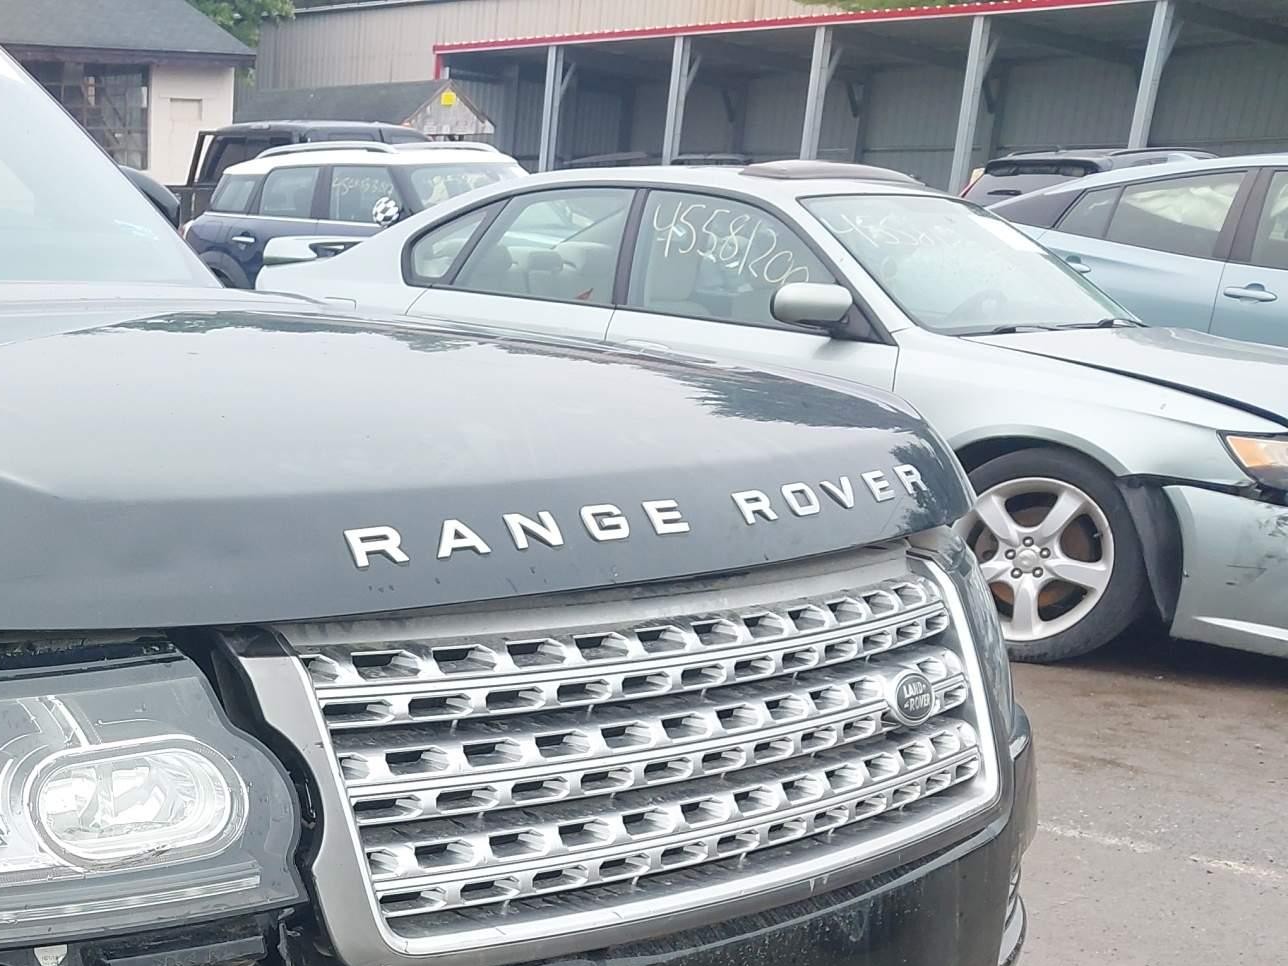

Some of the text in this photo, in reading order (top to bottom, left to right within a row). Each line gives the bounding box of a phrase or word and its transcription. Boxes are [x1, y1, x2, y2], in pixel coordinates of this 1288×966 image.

[343, 463, 929, 568] RANGE ROVER
[902, 682, 923, 698] LAND
[909, 694, 930, 711] ROVER
